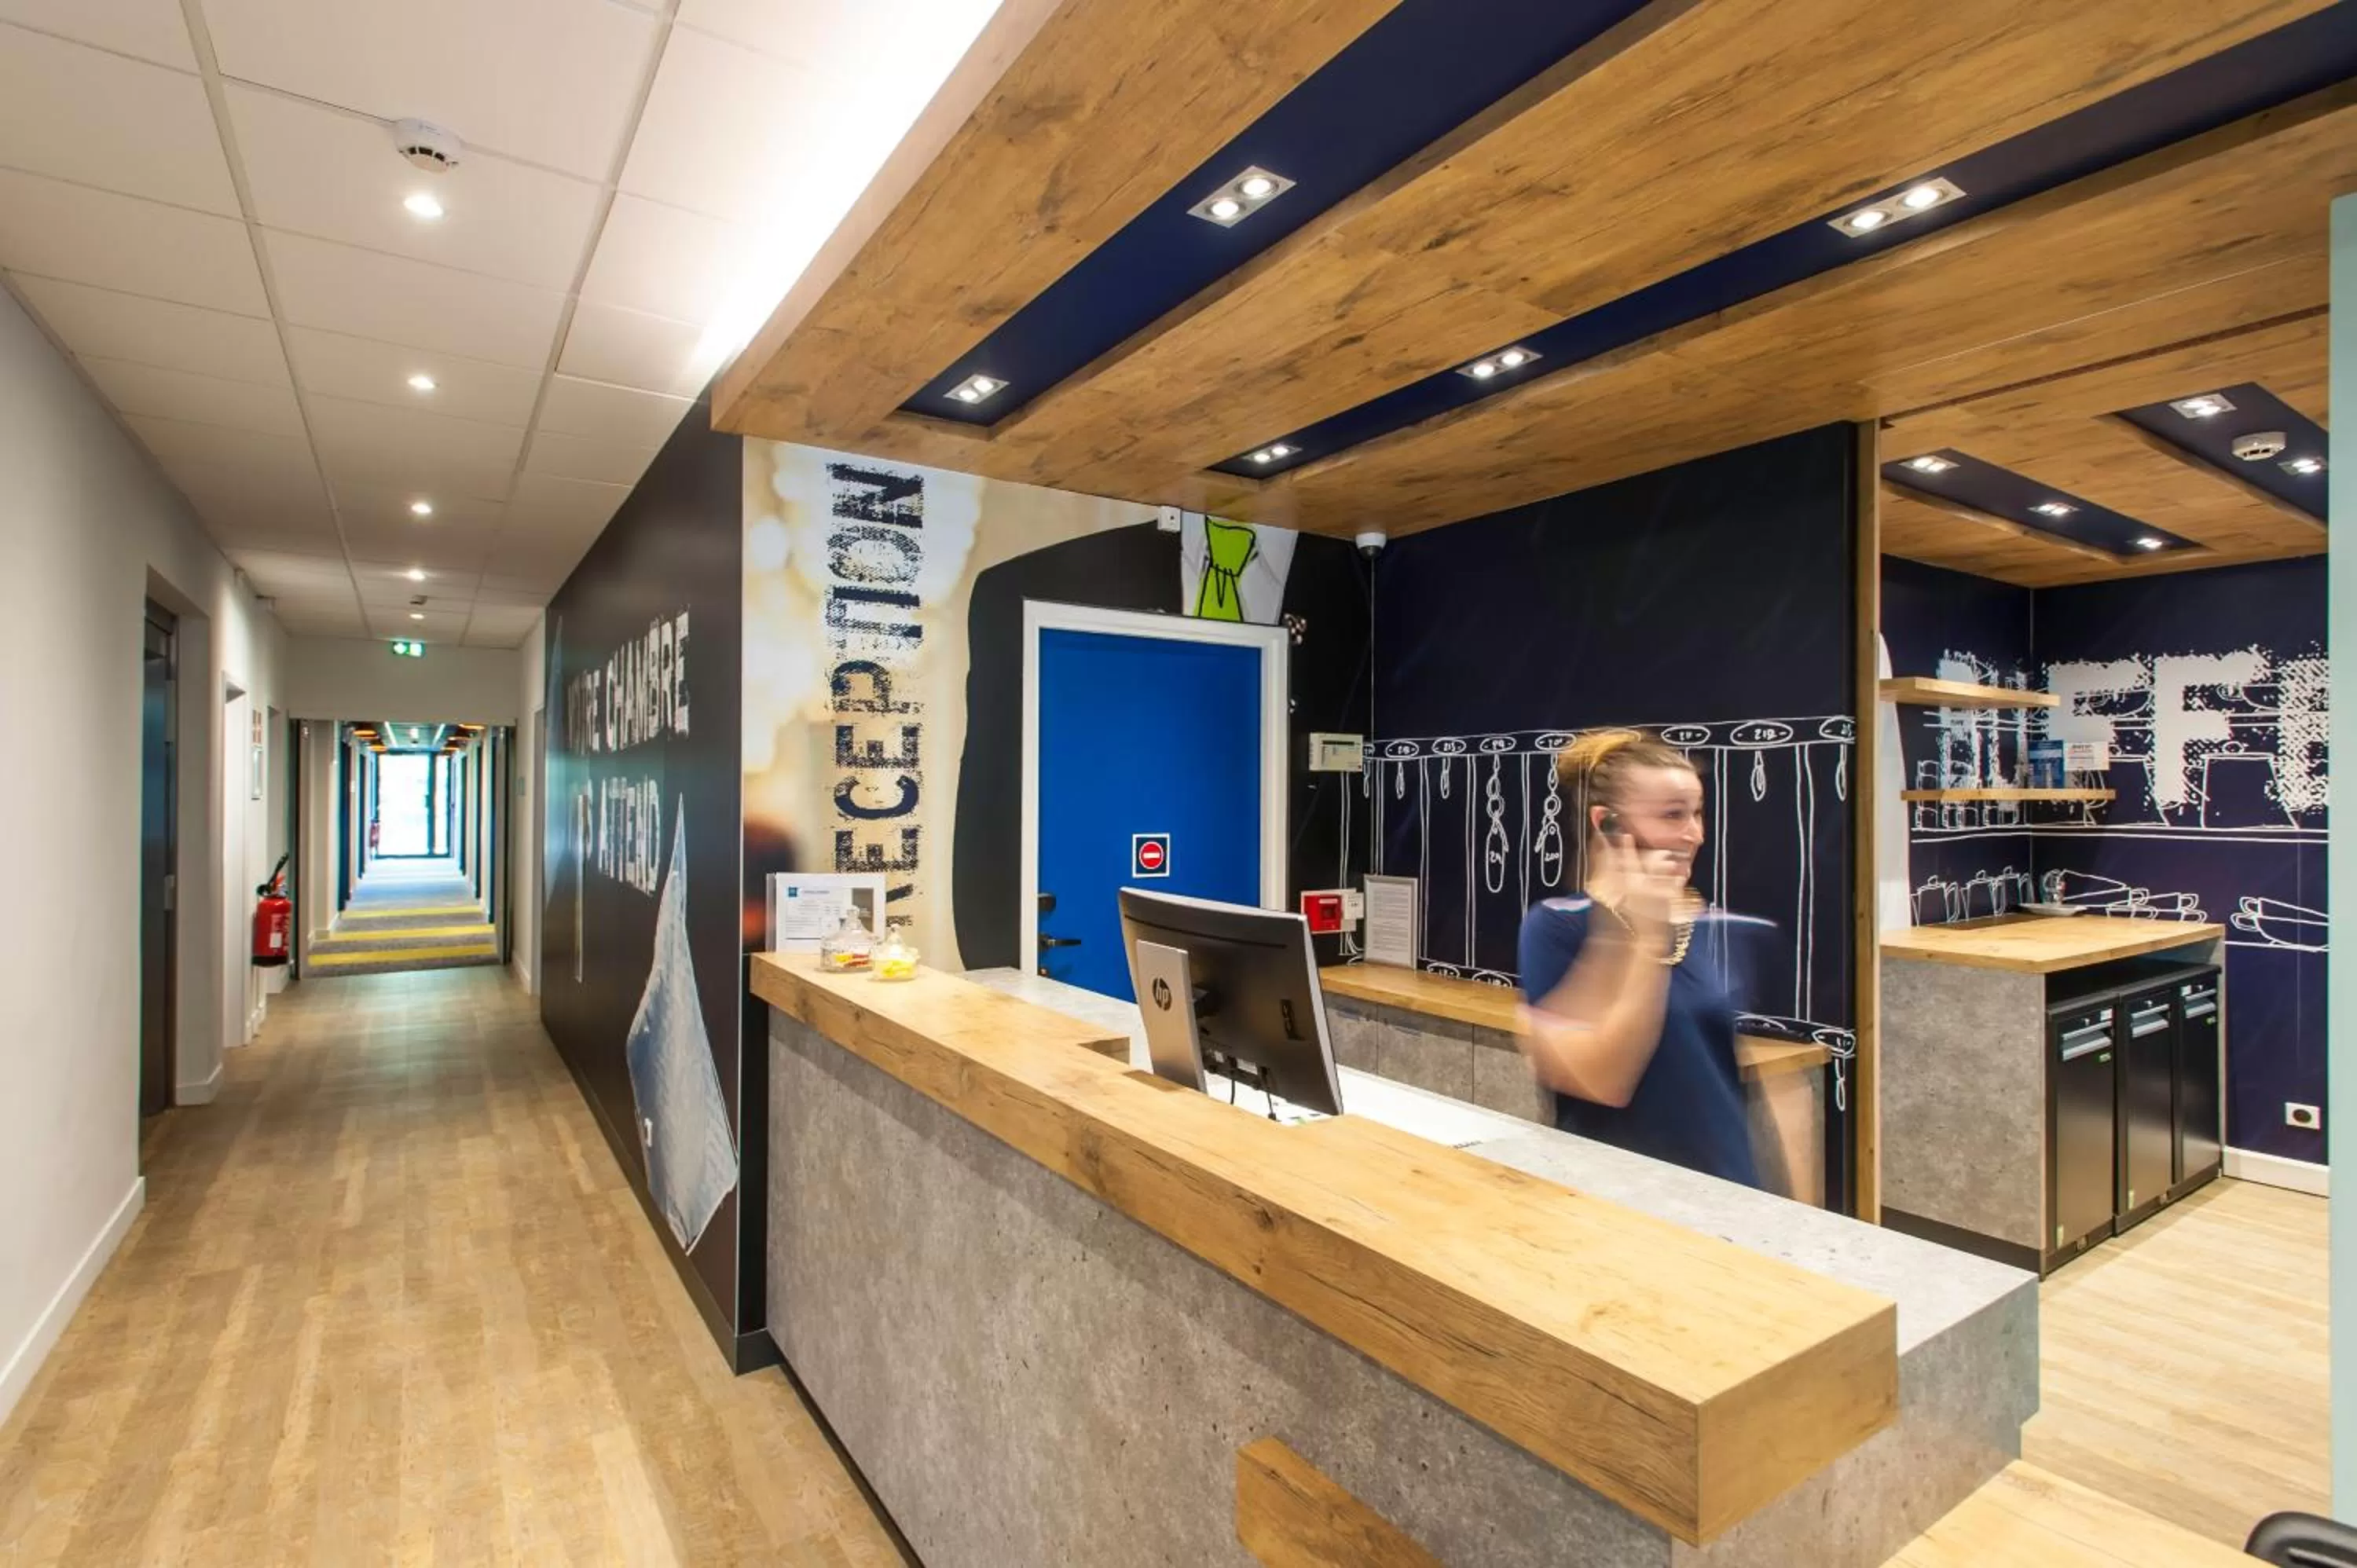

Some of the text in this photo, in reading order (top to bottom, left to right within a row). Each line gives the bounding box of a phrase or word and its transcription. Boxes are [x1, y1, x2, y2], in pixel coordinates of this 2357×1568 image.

[606, 608, 690, 753] CHAMBRE
[598, 775, 660, 896] ATTEND
[1152, 976, 1172, 1012] hp
